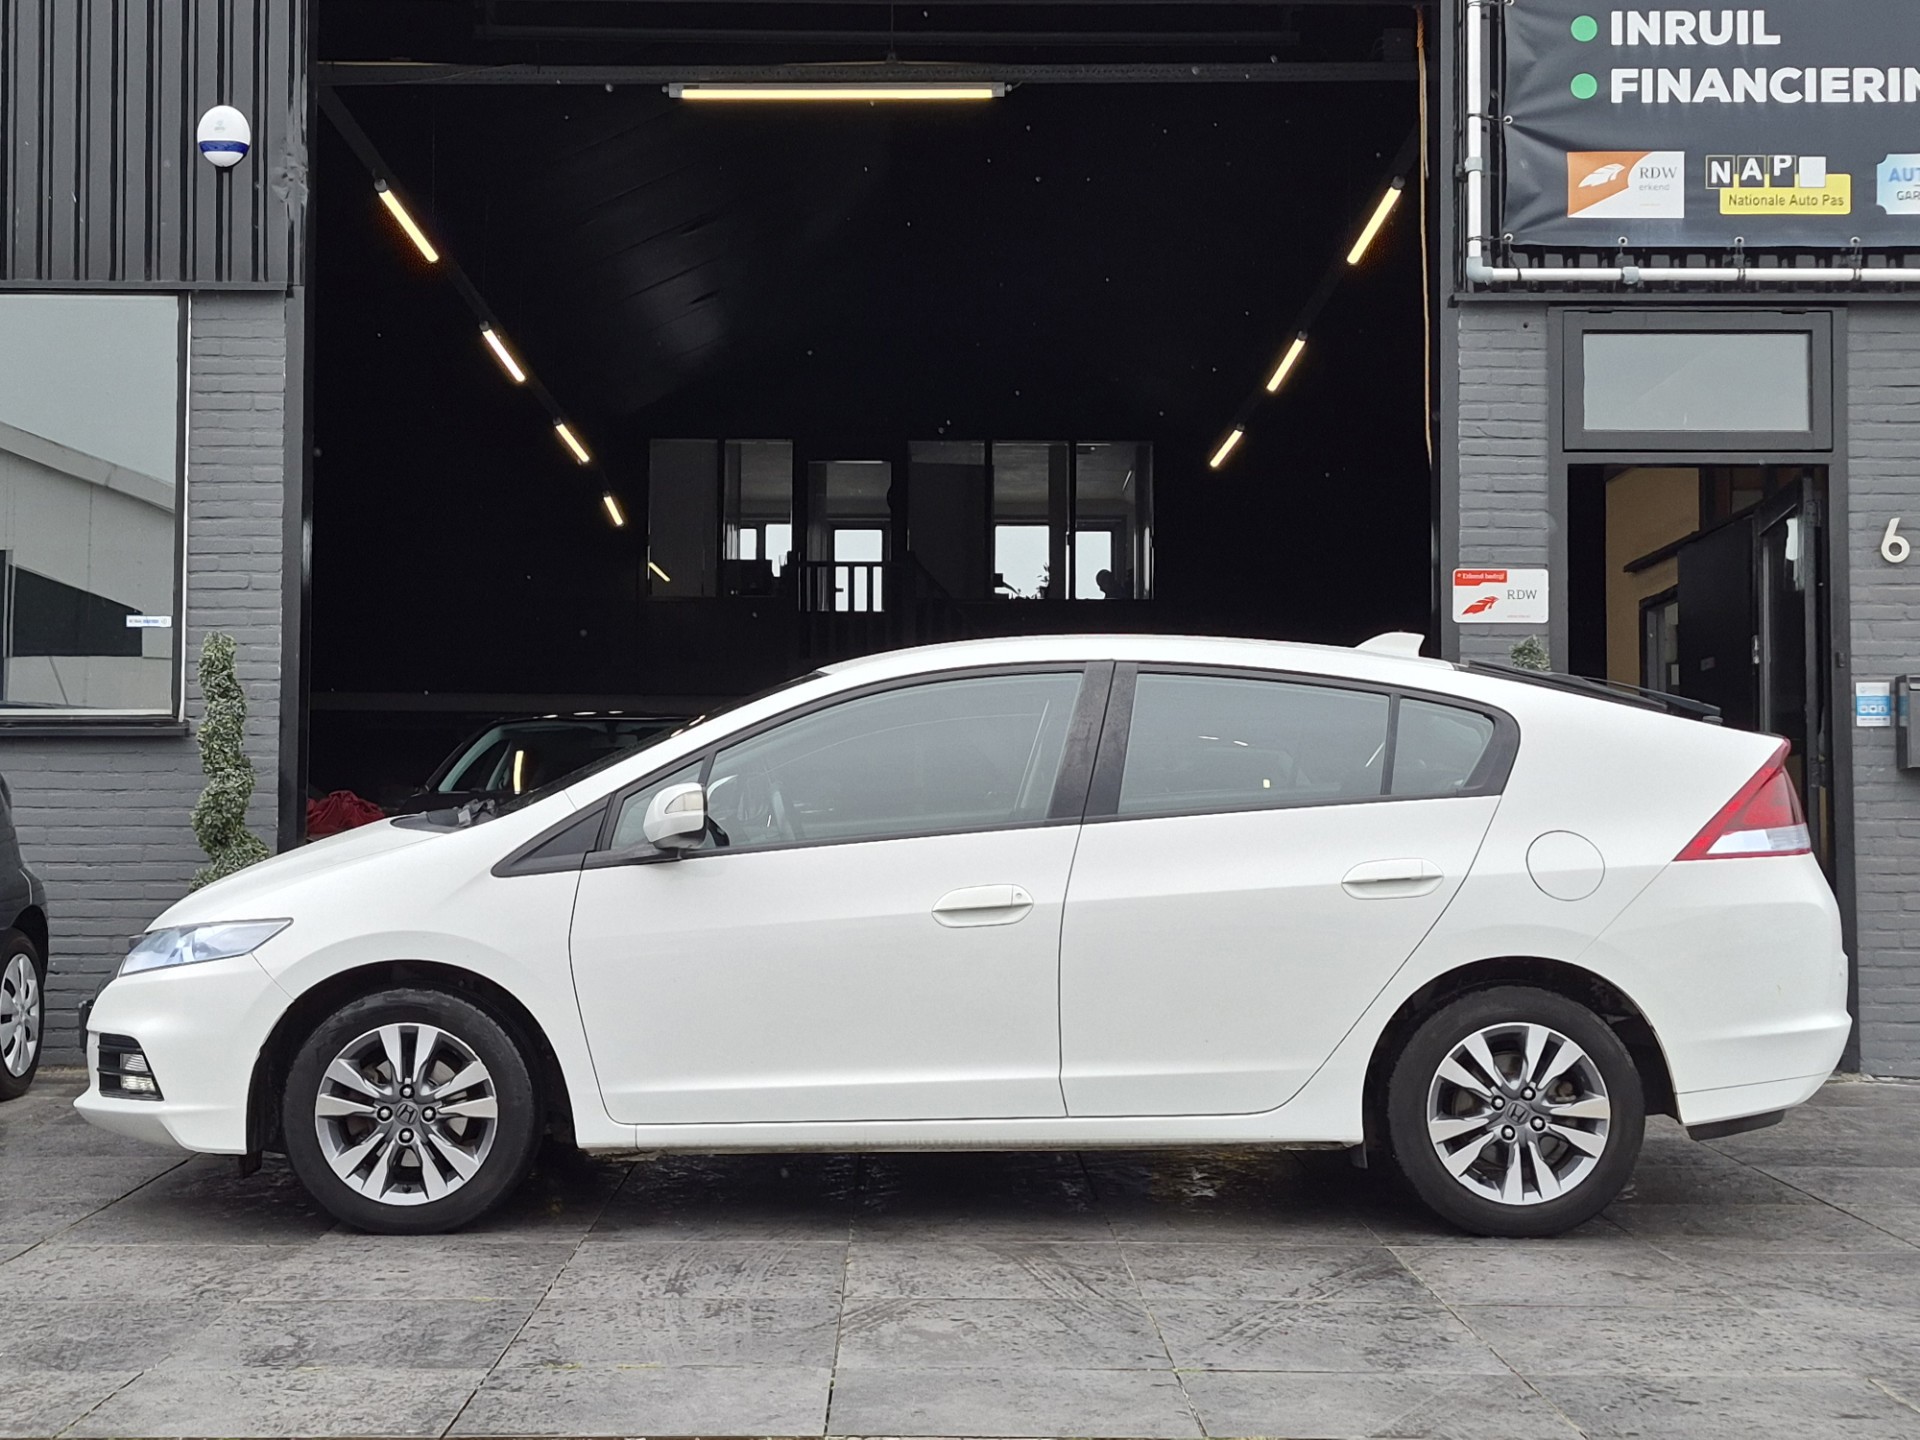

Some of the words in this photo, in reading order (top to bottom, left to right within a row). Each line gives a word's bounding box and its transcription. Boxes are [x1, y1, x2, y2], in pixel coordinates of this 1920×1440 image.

[1610, 10, 1781, 46] INRUIL
[1640, 166, 1678, 179] RDW
[1711, 155, 1793, 184] NAP
[1728, 194, 1786, 206] Nationale
[1789, 194, 1818, 206] Auto
[1822, 194, 1844, 206] Pas
[1881, 517, 1910, 563] 6
[1507, 589, 1537, 600] RDW
